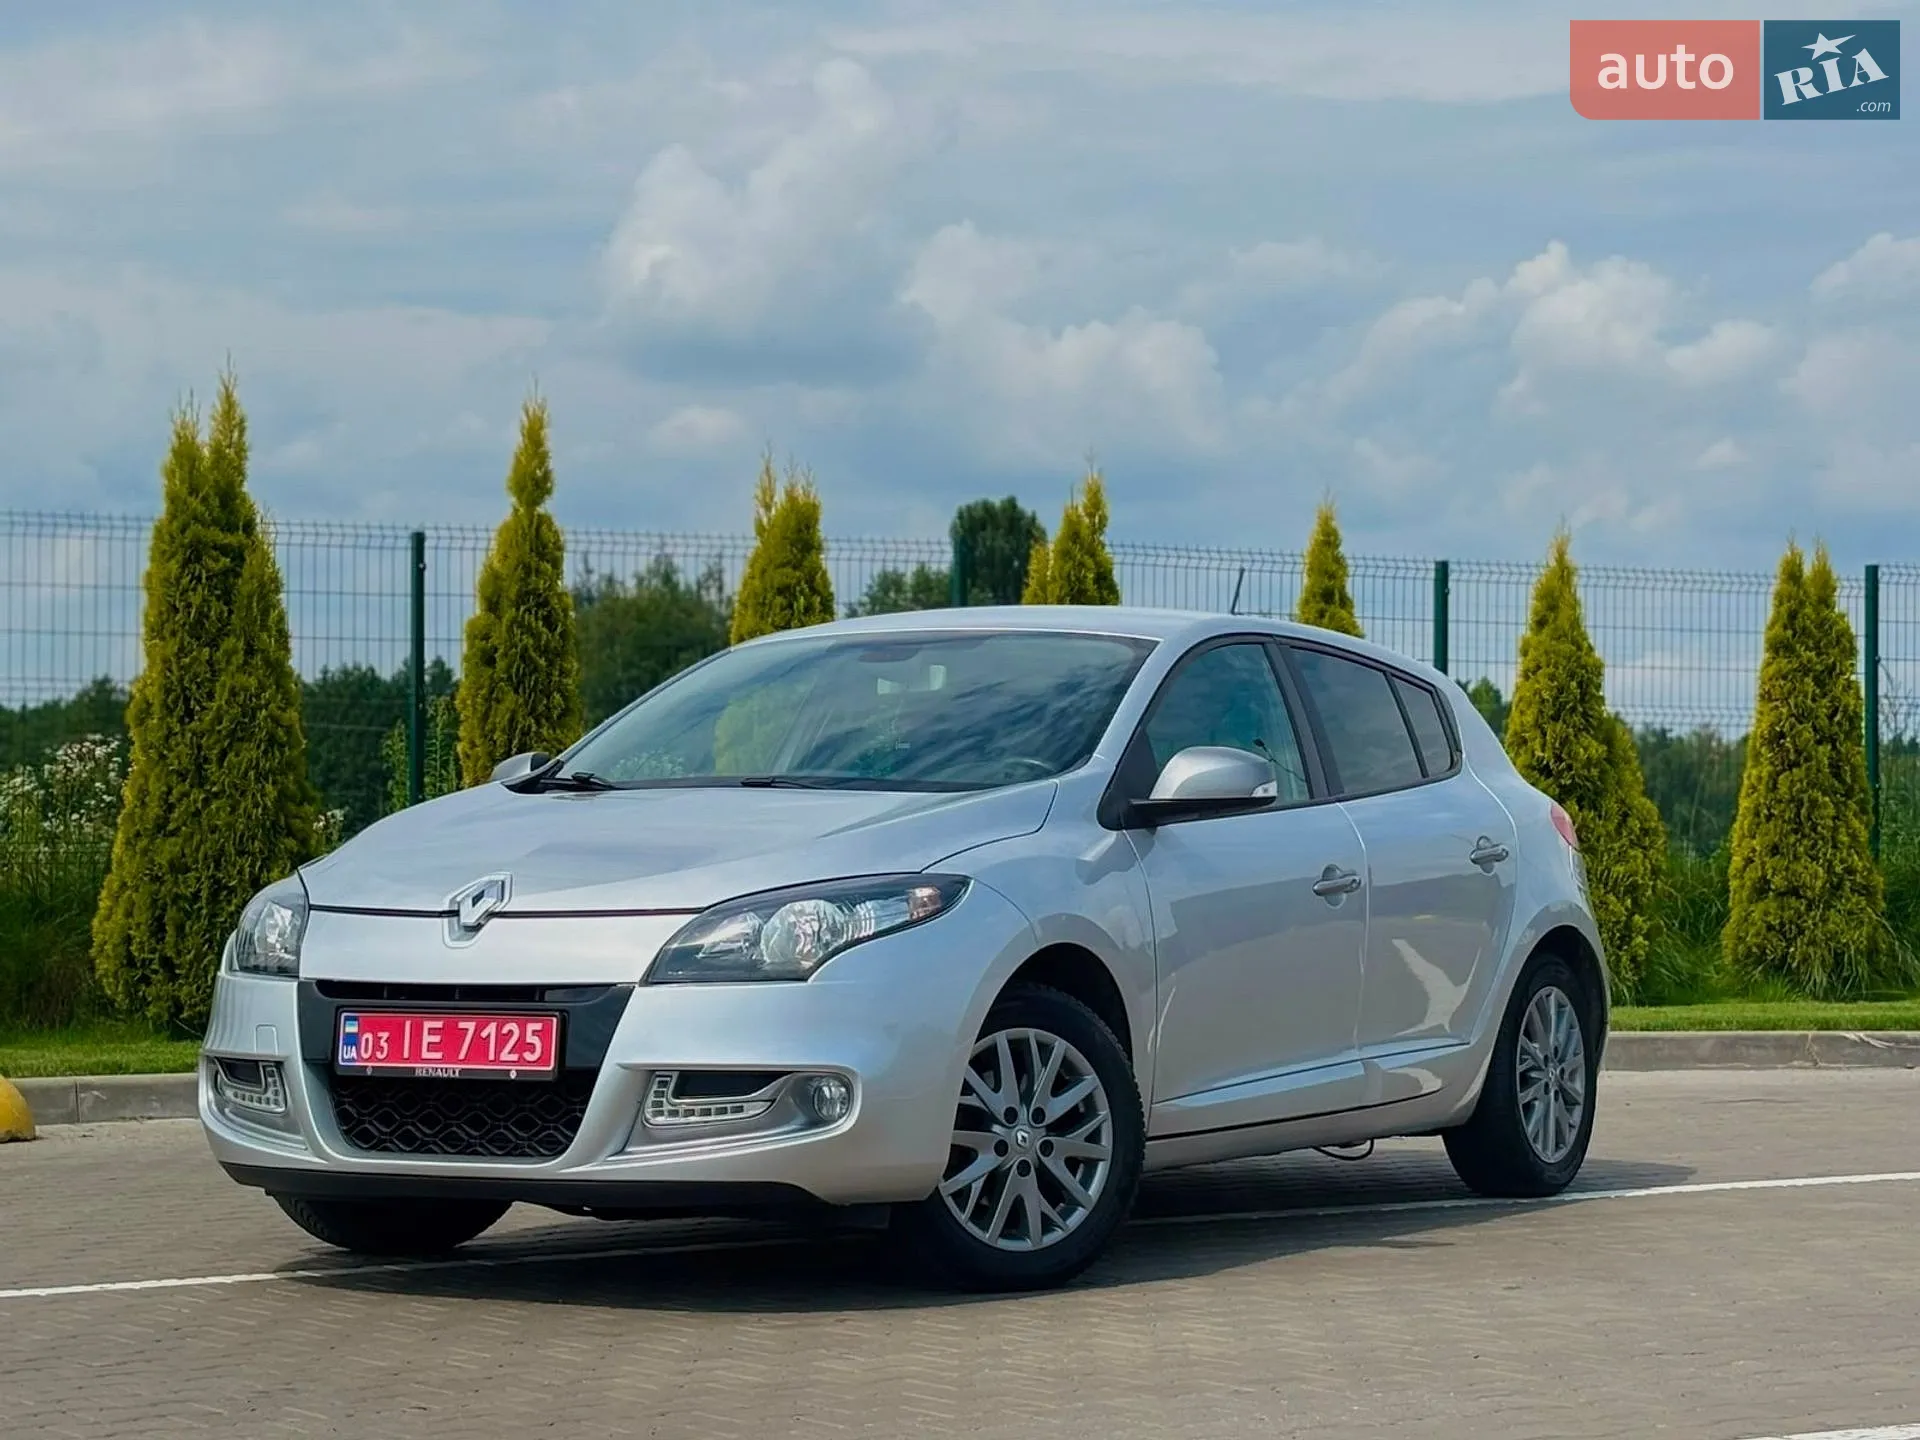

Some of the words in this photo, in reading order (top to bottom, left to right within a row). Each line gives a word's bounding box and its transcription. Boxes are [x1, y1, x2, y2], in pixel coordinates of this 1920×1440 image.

[361, 1032, 390, 1059] 03
[403, 1020, 444, 1060] IE
[458, 1021, 543, 1062] 7125
[343, 1046, 357, 1060] UA
[415, 1067, 461, 1077] RENAULT
